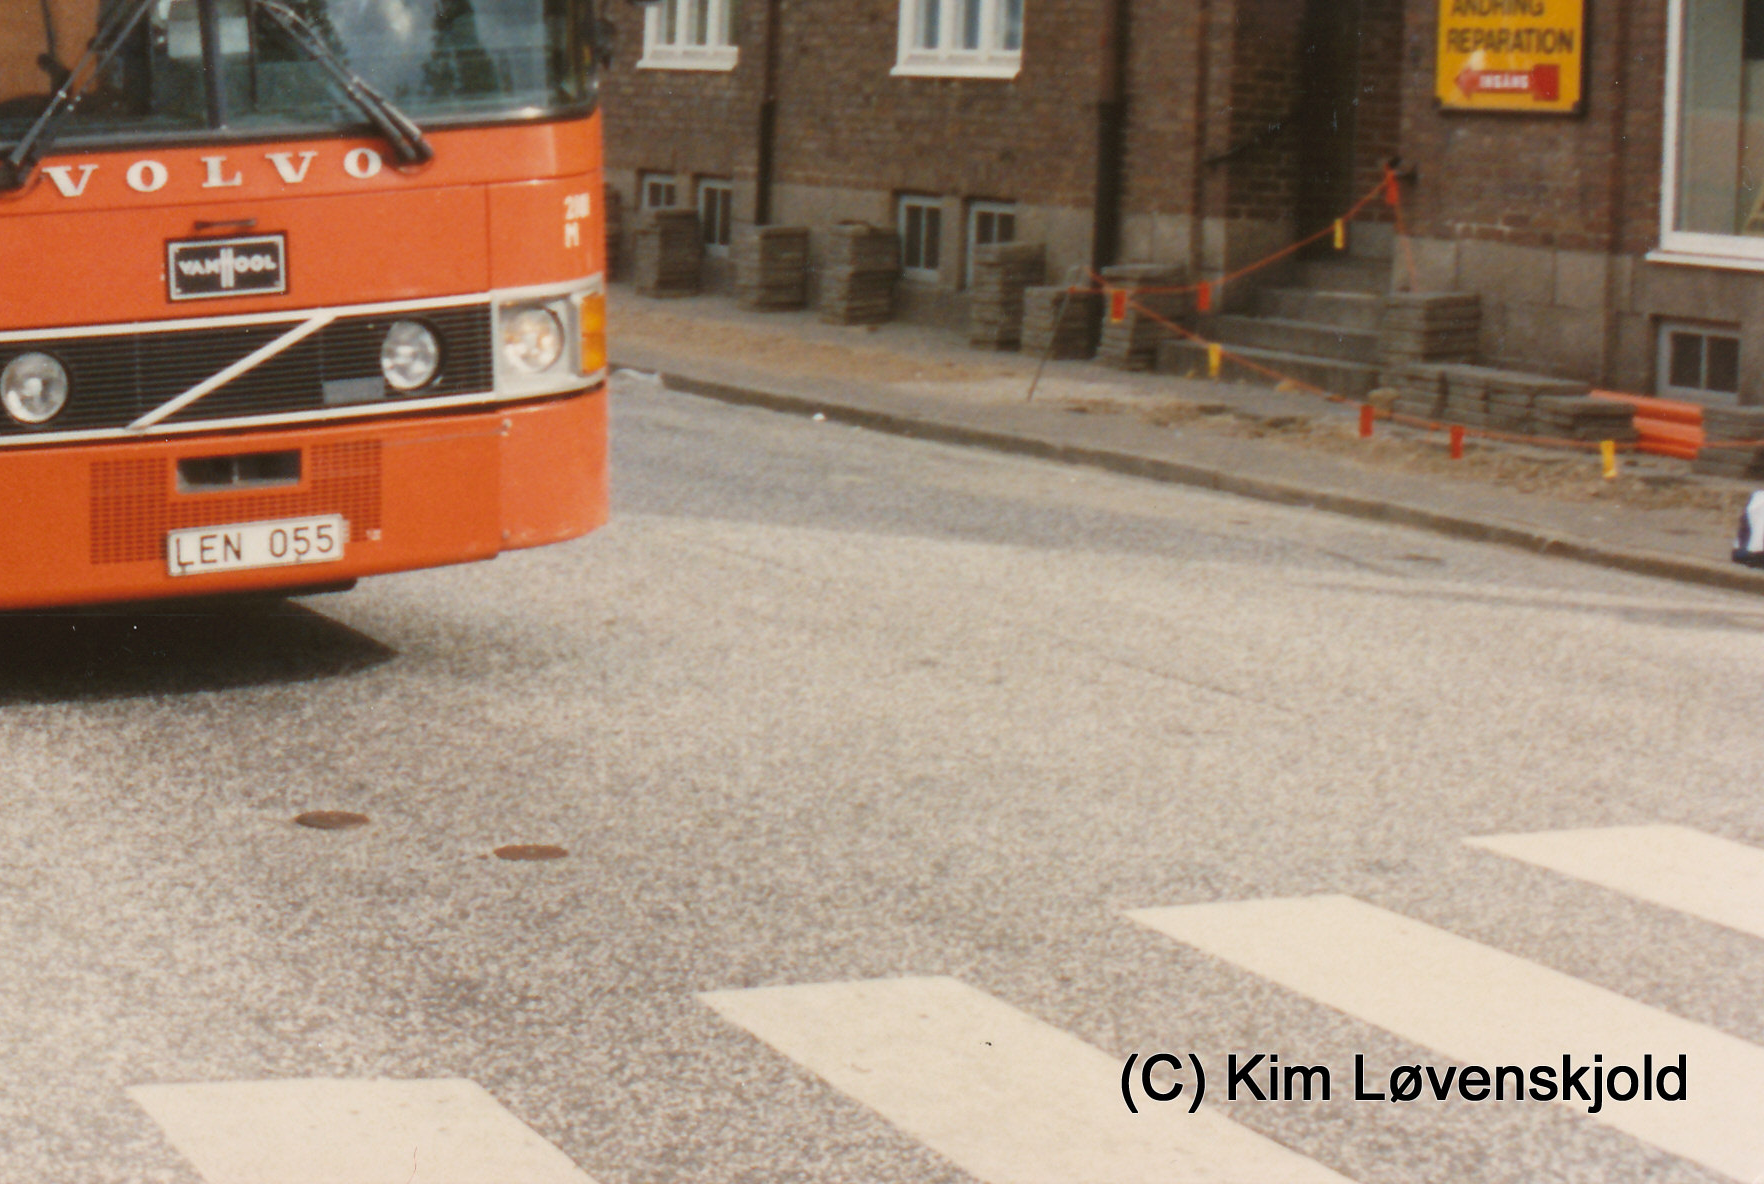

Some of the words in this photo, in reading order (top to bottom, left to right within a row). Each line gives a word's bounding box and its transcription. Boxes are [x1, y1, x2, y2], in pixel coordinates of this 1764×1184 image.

[1446, 27, 1574, 54] REPARATION
[41, 147, 383, 197] VOLVO
[176, 531, 242, 566] LEN
[269, 523, 334, 558] 055
